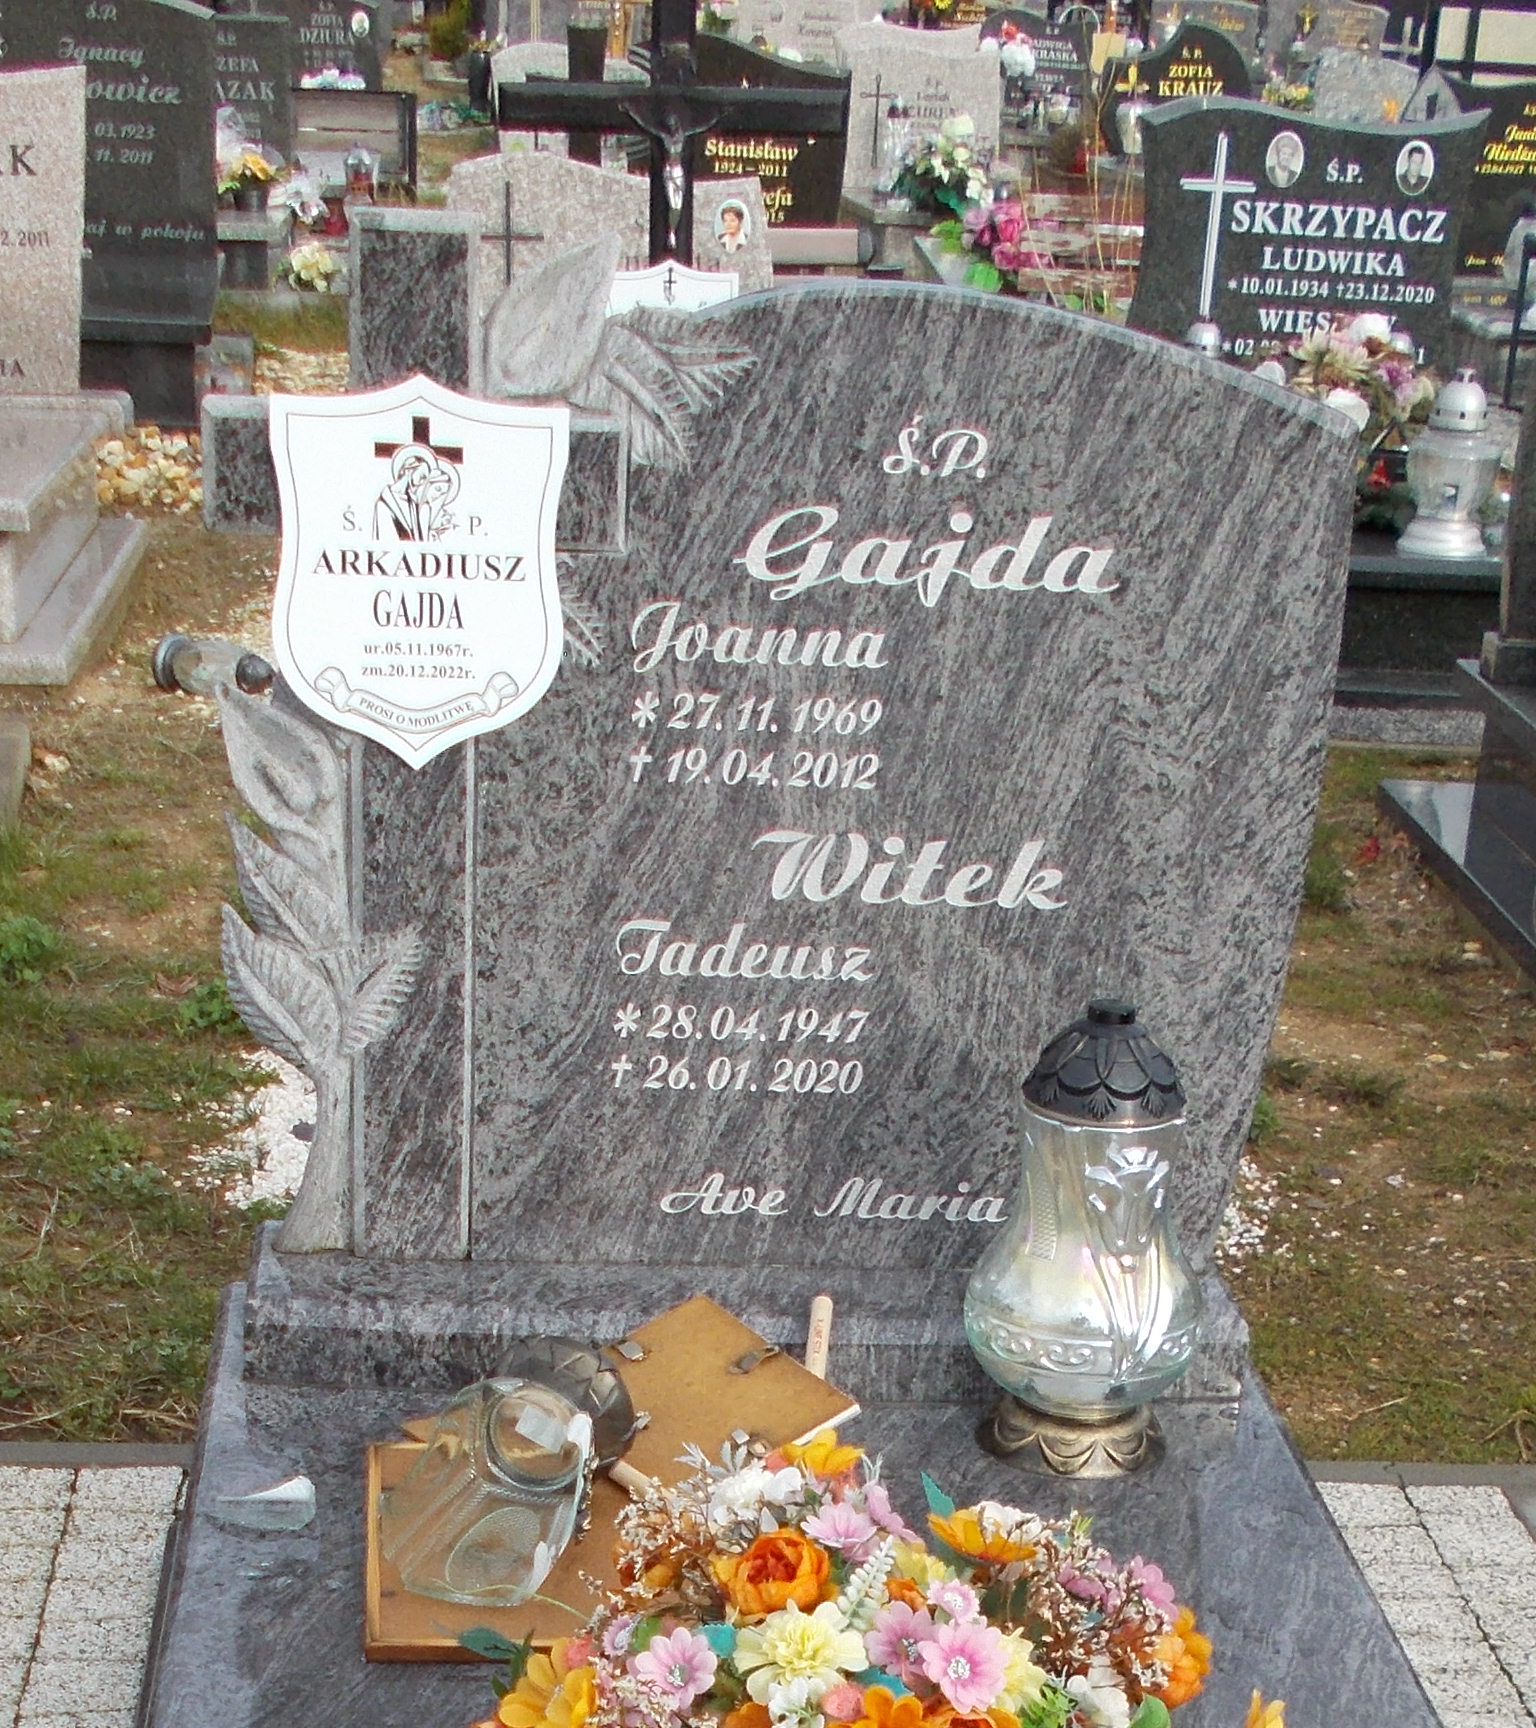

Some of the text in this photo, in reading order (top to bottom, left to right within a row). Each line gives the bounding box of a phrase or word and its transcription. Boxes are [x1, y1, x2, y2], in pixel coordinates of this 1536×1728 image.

[1158, 80, 1224, 97] KRAUZ
[1168, 63, 1214, 79] ZOFIA
[704, 138, 799, 162] Stanisław
[1231, 200, 1448, 244] SKRZYPACZ
[1261, 246, 1405, 277] LUDWIKA
[312, 548, 527, 582] ARKADIUSZ
[731, 504, 1121, 608] Gajda
[372, 589, 464, 630] GAJDA
[630, 601, 889, 674] Joanna
[359, 697, 394, 720] PROSI
[396, 714, 405, 724] O
[751, 830, 1069, 912] Witek
[615, 917, 875, 982] Tadeusz
[660, 1171, 1009, 1223] Ave Maria
